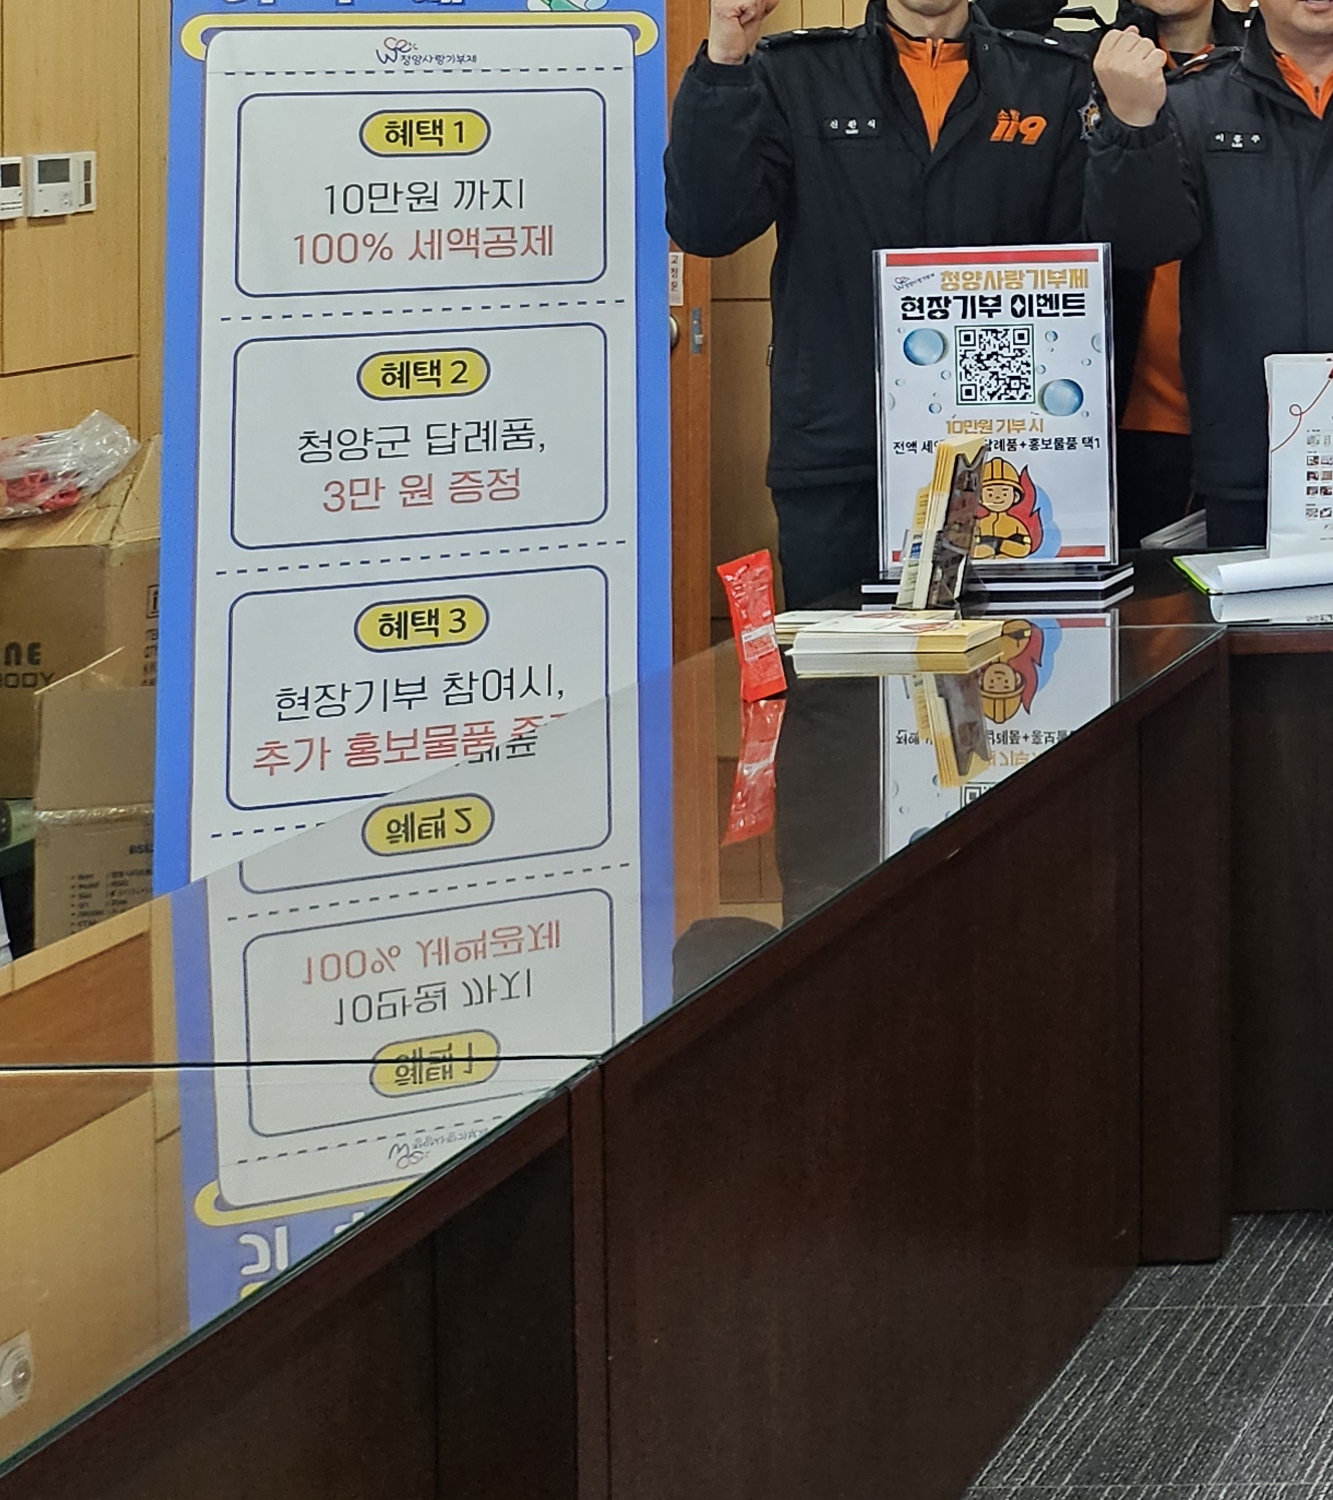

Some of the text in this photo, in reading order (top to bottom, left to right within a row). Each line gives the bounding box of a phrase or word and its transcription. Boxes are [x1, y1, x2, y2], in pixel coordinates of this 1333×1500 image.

[384, 118, 465, 148] 혜택 1
[989, 115, 1047, 146] 119
[323, 178, 526, 217] 10만원 까지
[293, 224, 556, 266] 100% 세액공제
[939, 268, 1089, 293] 청양사랑기부제
[900, 292, 1086, 321] 현장기부 이벤트
[379, 359, 470, 390] 혜택 2
[297, 416, 548, 465] 청양군 답례품,
[945, 418, 1044, 435] 10만원 기부 시
[893, 440, 918, 455] 전액
[1081, 435, 1101, 450] 택1
[321, 467, 522, 514] 3만 원 증정
[377, 606, 468, 640] 혜택 3
[274, 664, 565, 722] 현장기부 참여시,
[251, 735, 332, 778] 추가
[343, 717, 497, 770] 홍보물품
